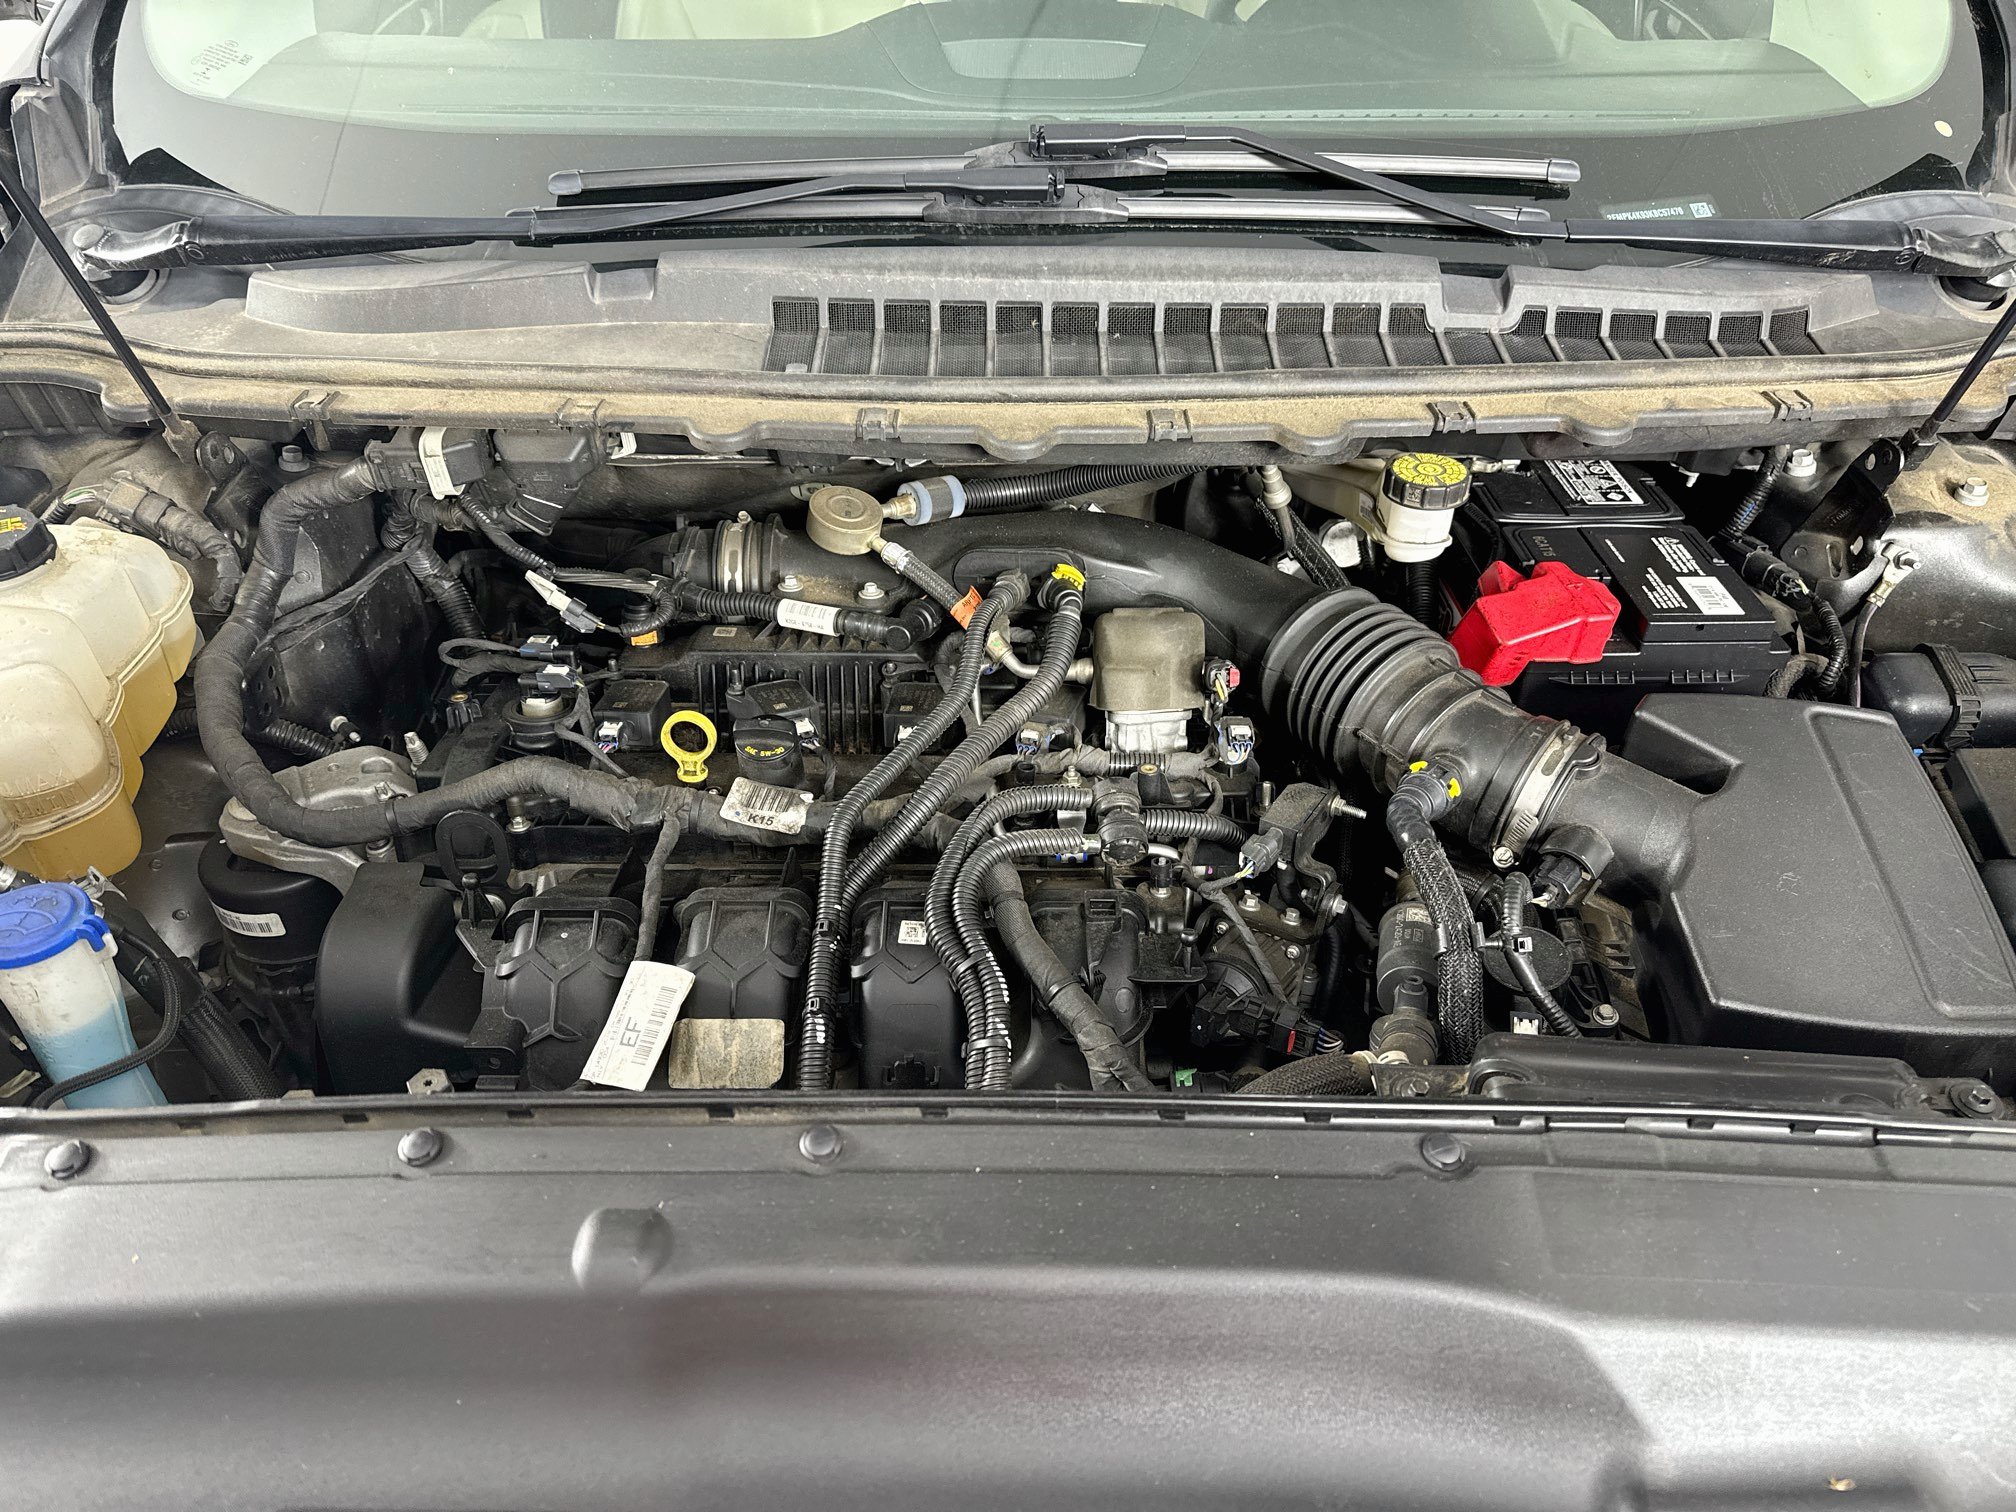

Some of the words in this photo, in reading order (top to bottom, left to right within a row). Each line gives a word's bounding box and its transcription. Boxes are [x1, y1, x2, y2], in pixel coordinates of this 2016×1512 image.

[744, 746, 758, 756] SAE
[760, 747, 785, 757] 5W-30
[23, 788, 80, 816] MIN
[747, 813, 775, 826] K15
[619, 1016, 642, 1048] EF
